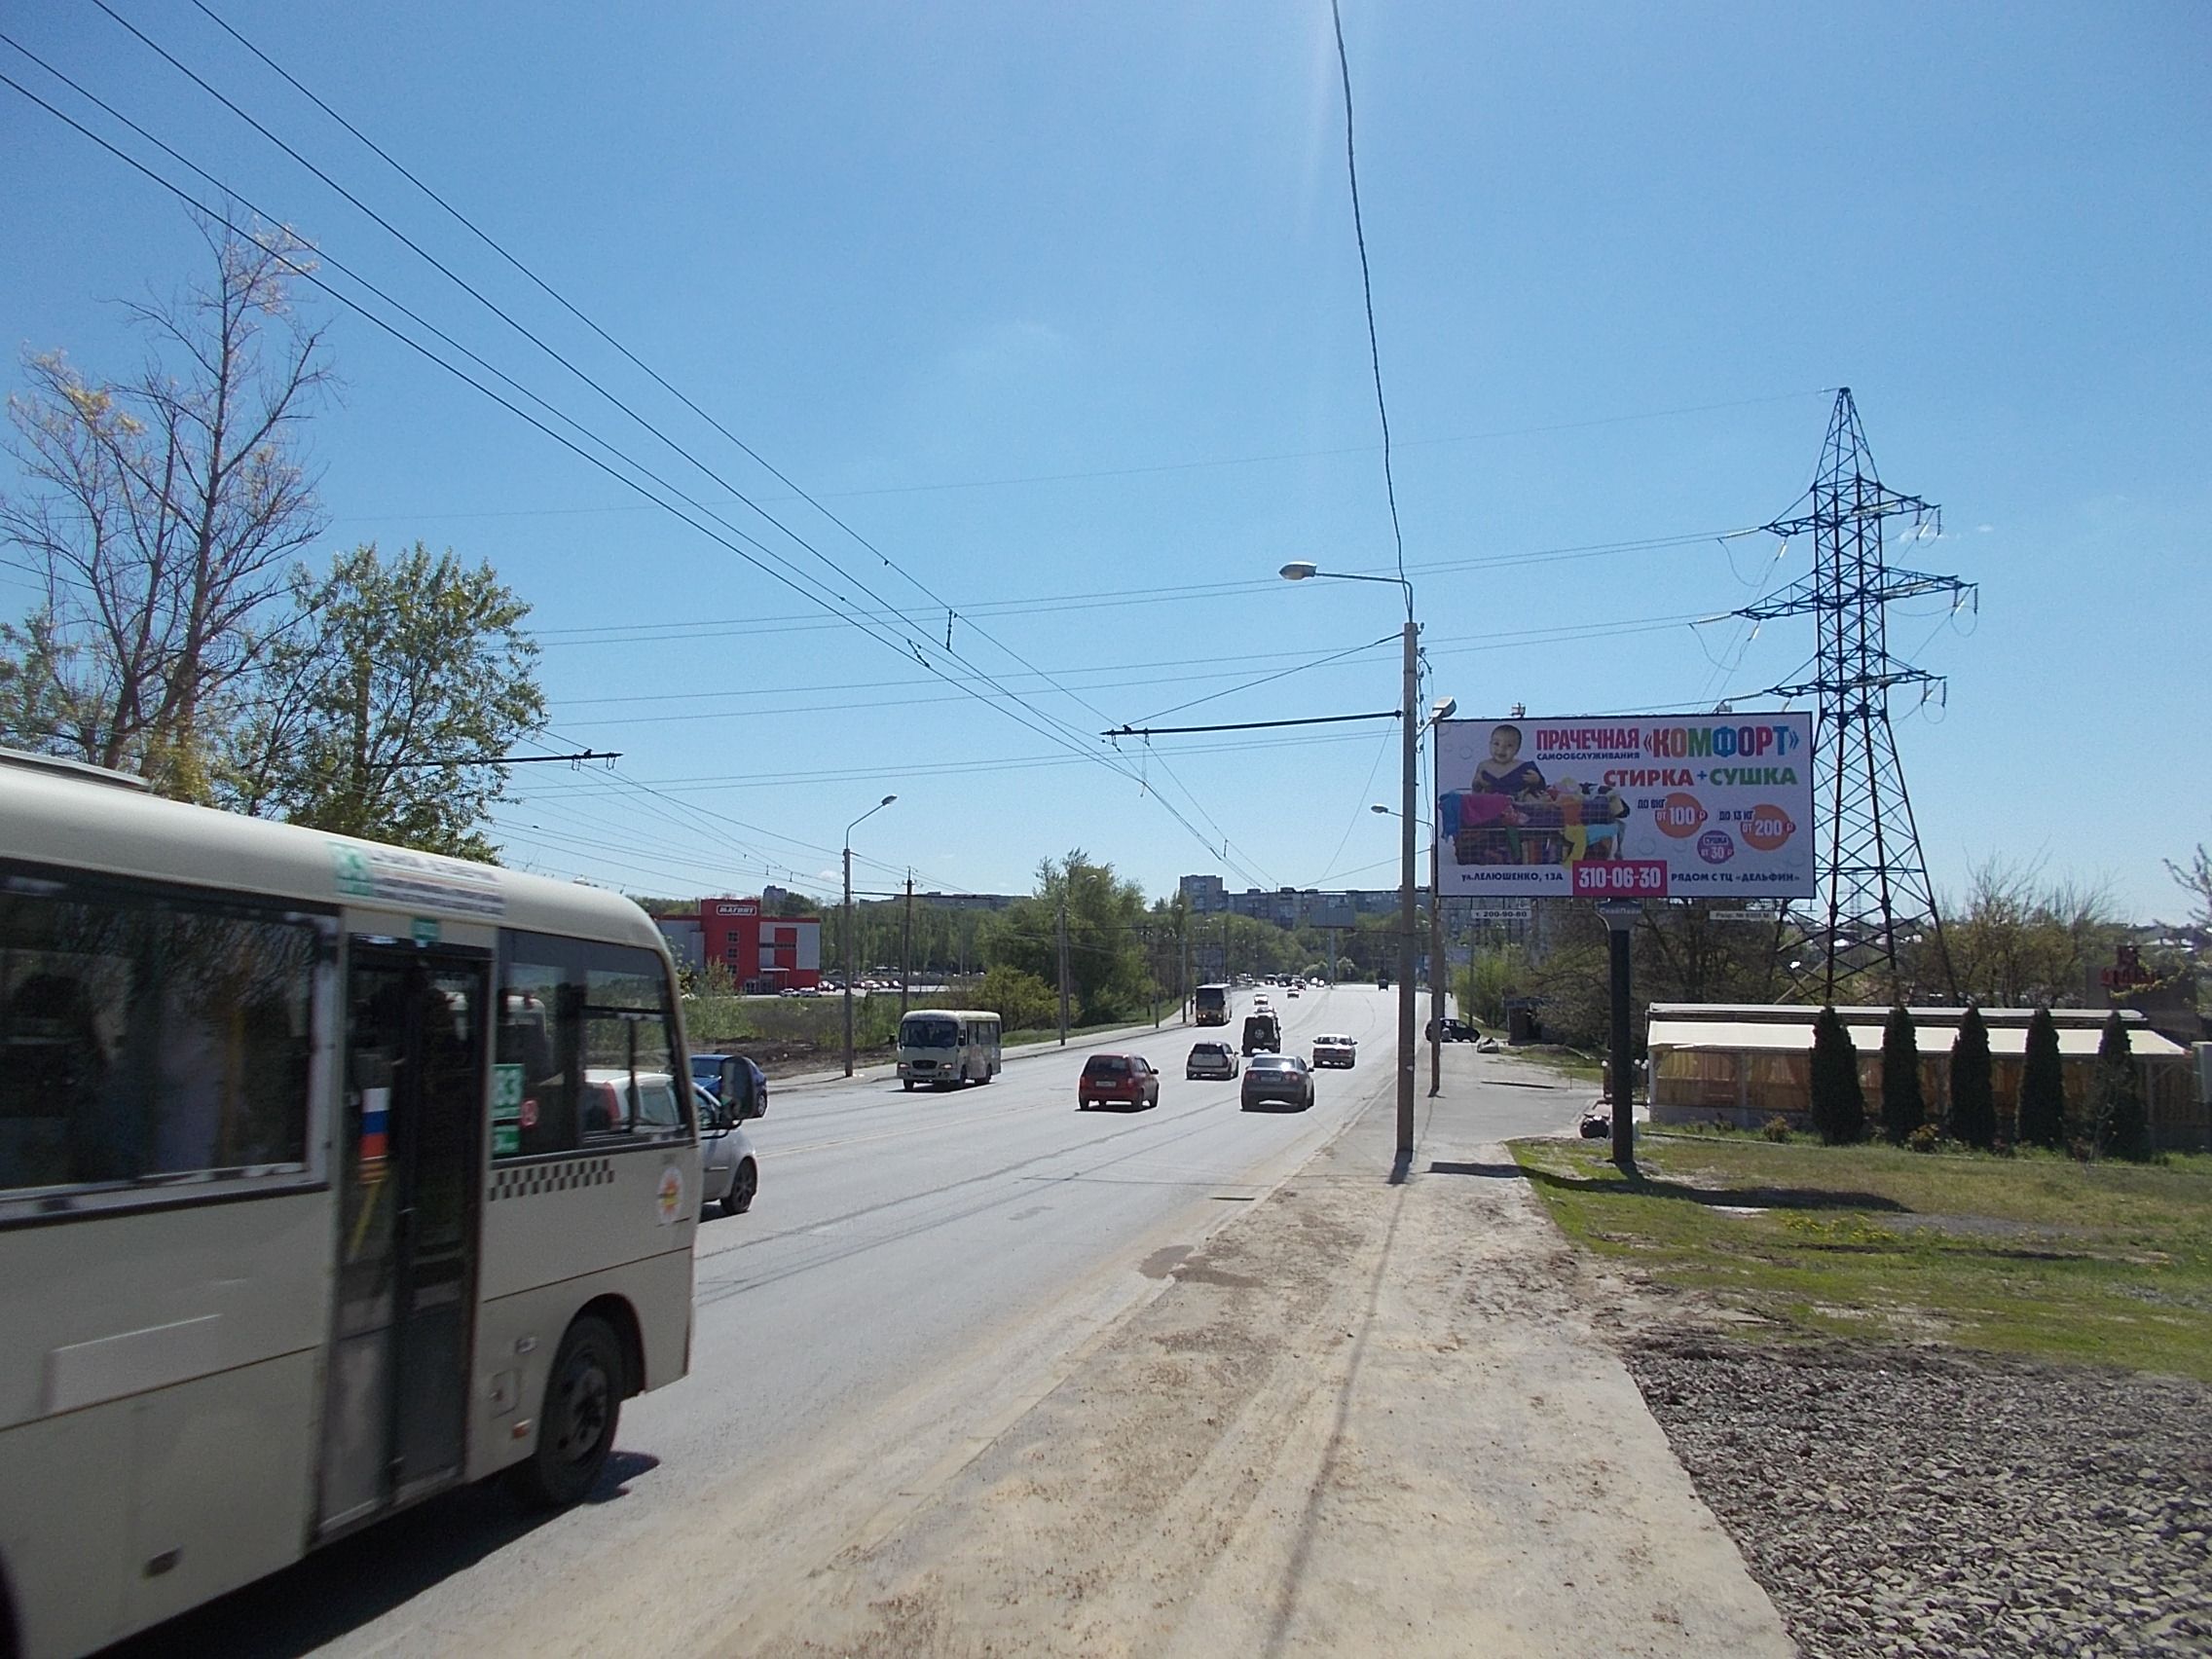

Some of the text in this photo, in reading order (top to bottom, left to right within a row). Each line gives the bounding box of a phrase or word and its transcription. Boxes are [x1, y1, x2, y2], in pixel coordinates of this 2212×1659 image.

[1536, 725, 1799, 757] ПРАЧЕЧНАЯ «КОМФОРТ»
[1604, 769, 1694, 787] СТИРКА
[1710, 767, 1797, 786] СУШКА
[1638, 799, 1649, 808] ДО
[1670, 807, 1695, 826] 100
[1719, 811, 1730, 821] ДО
[1755, 820, 1783, 836] 200
[1711, 846, 1724, 859] 30
[1578, 866, 1661, 888] 310-06-30
[1720, 873, 1733, 882] ТЦ
